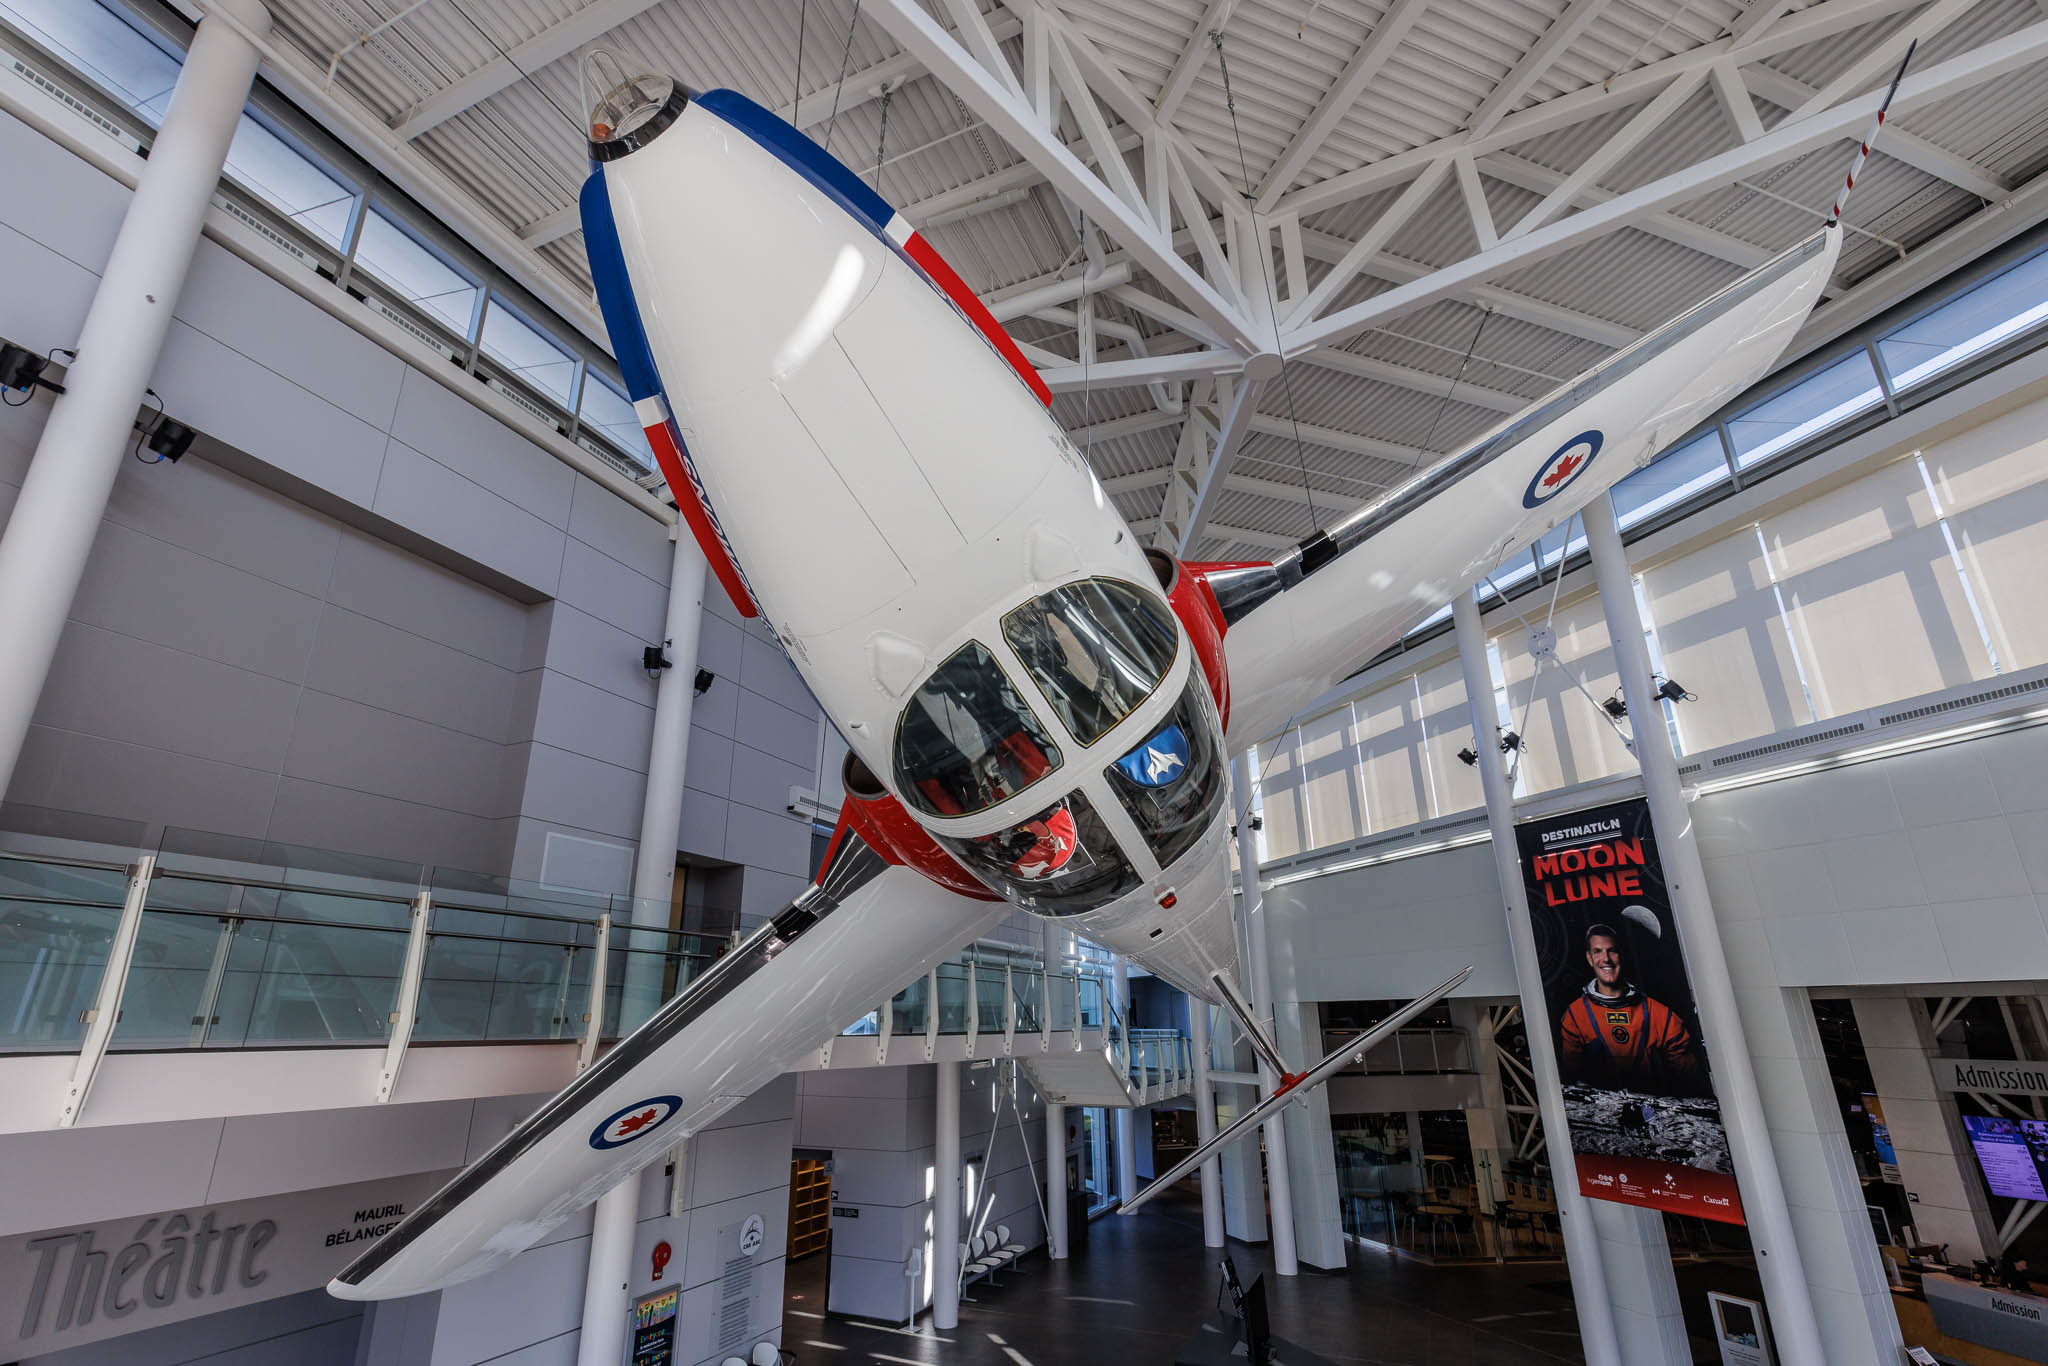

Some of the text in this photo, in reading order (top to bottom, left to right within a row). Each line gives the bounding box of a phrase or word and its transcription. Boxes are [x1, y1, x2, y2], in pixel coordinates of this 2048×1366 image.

[1542, 819, 1621, 842] DESTINATION
[1533, 836, 1645, 880] MOON
[1545, 868, 1643, 907] LUNE
[1955, 1064, 2048, 1091] Admission
[353, 1204, 405, 1223] MAURIL
[19, 1211, 277, 1339] Théâtre
[1992, 1297, 2040, 1320] Admission
